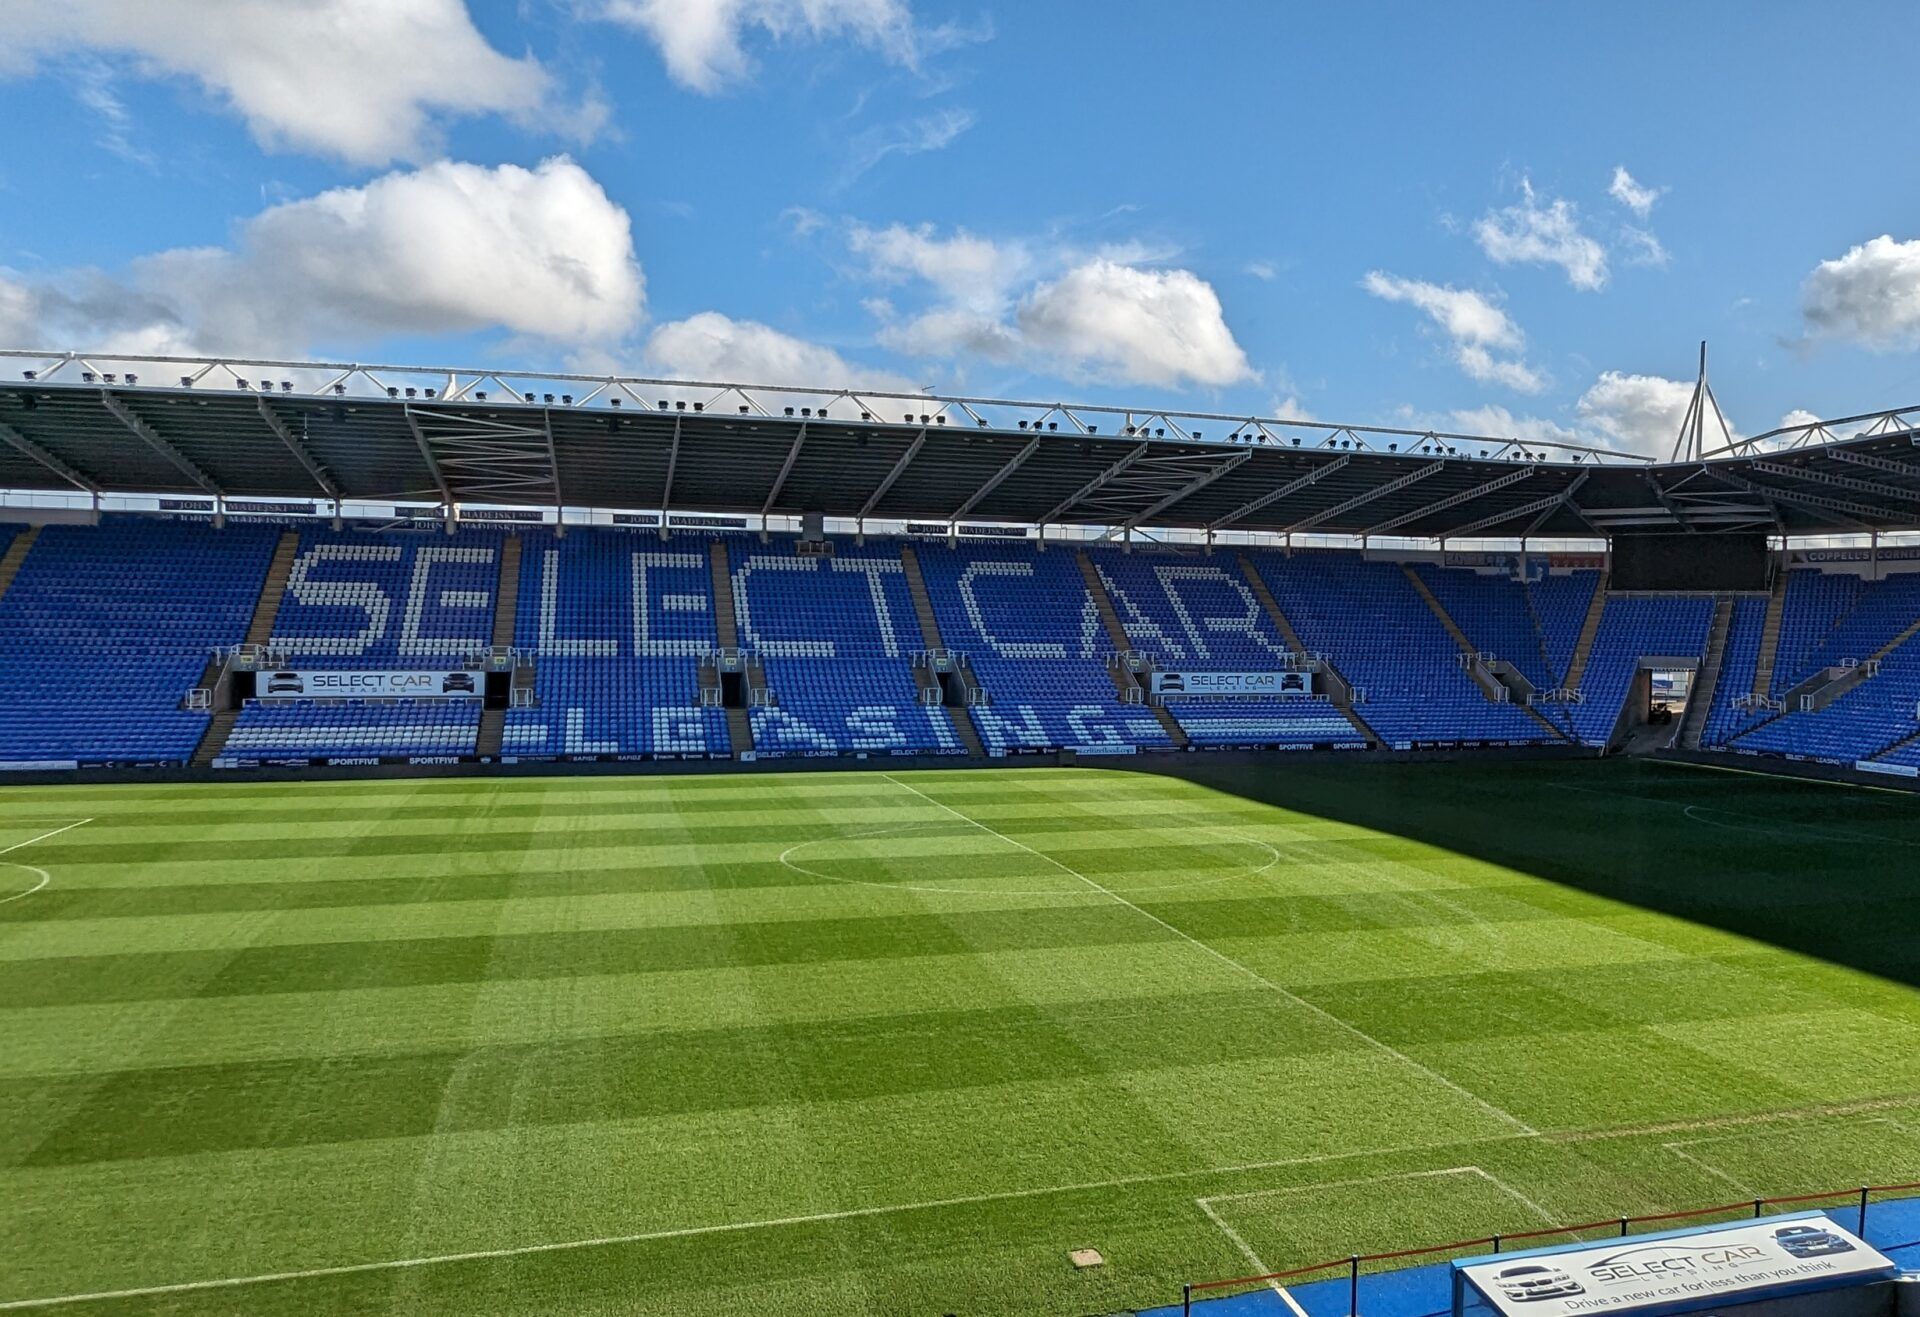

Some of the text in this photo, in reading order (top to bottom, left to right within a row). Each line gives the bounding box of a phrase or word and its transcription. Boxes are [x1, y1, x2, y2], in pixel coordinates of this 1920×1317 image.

[179, 501, 211, 510] JOHN
[228, 502, 289, 512] MADEJSKI
[461, 510, 516, 520] MADEJSKI
[630, 516, 658, 524] JOHN
[671, 516, 723, 526] MADEJSKI
[922, 525, 948, 533] JOHN
[960, 526, 1006, 535] MADEJSKI
[1809, 551, 1870, 561] COPPELL'S
[268, 544, 1296, 660] SELECT CAR
[313, 675, 432, 687] SELECT CAR
[1191, 675, 1274, 686] SELECT CAR
[328, 757, 380, 766] SPORTFIVE
[409, 757, 459, 765] SPORTFIVE
[1590, 1246, 1766, 1282] SELECT CAR
[1640, 1262, 1740, 1282] LEASING
[1564, 1260, 1837, 1310] Drive a new car for less than you think
